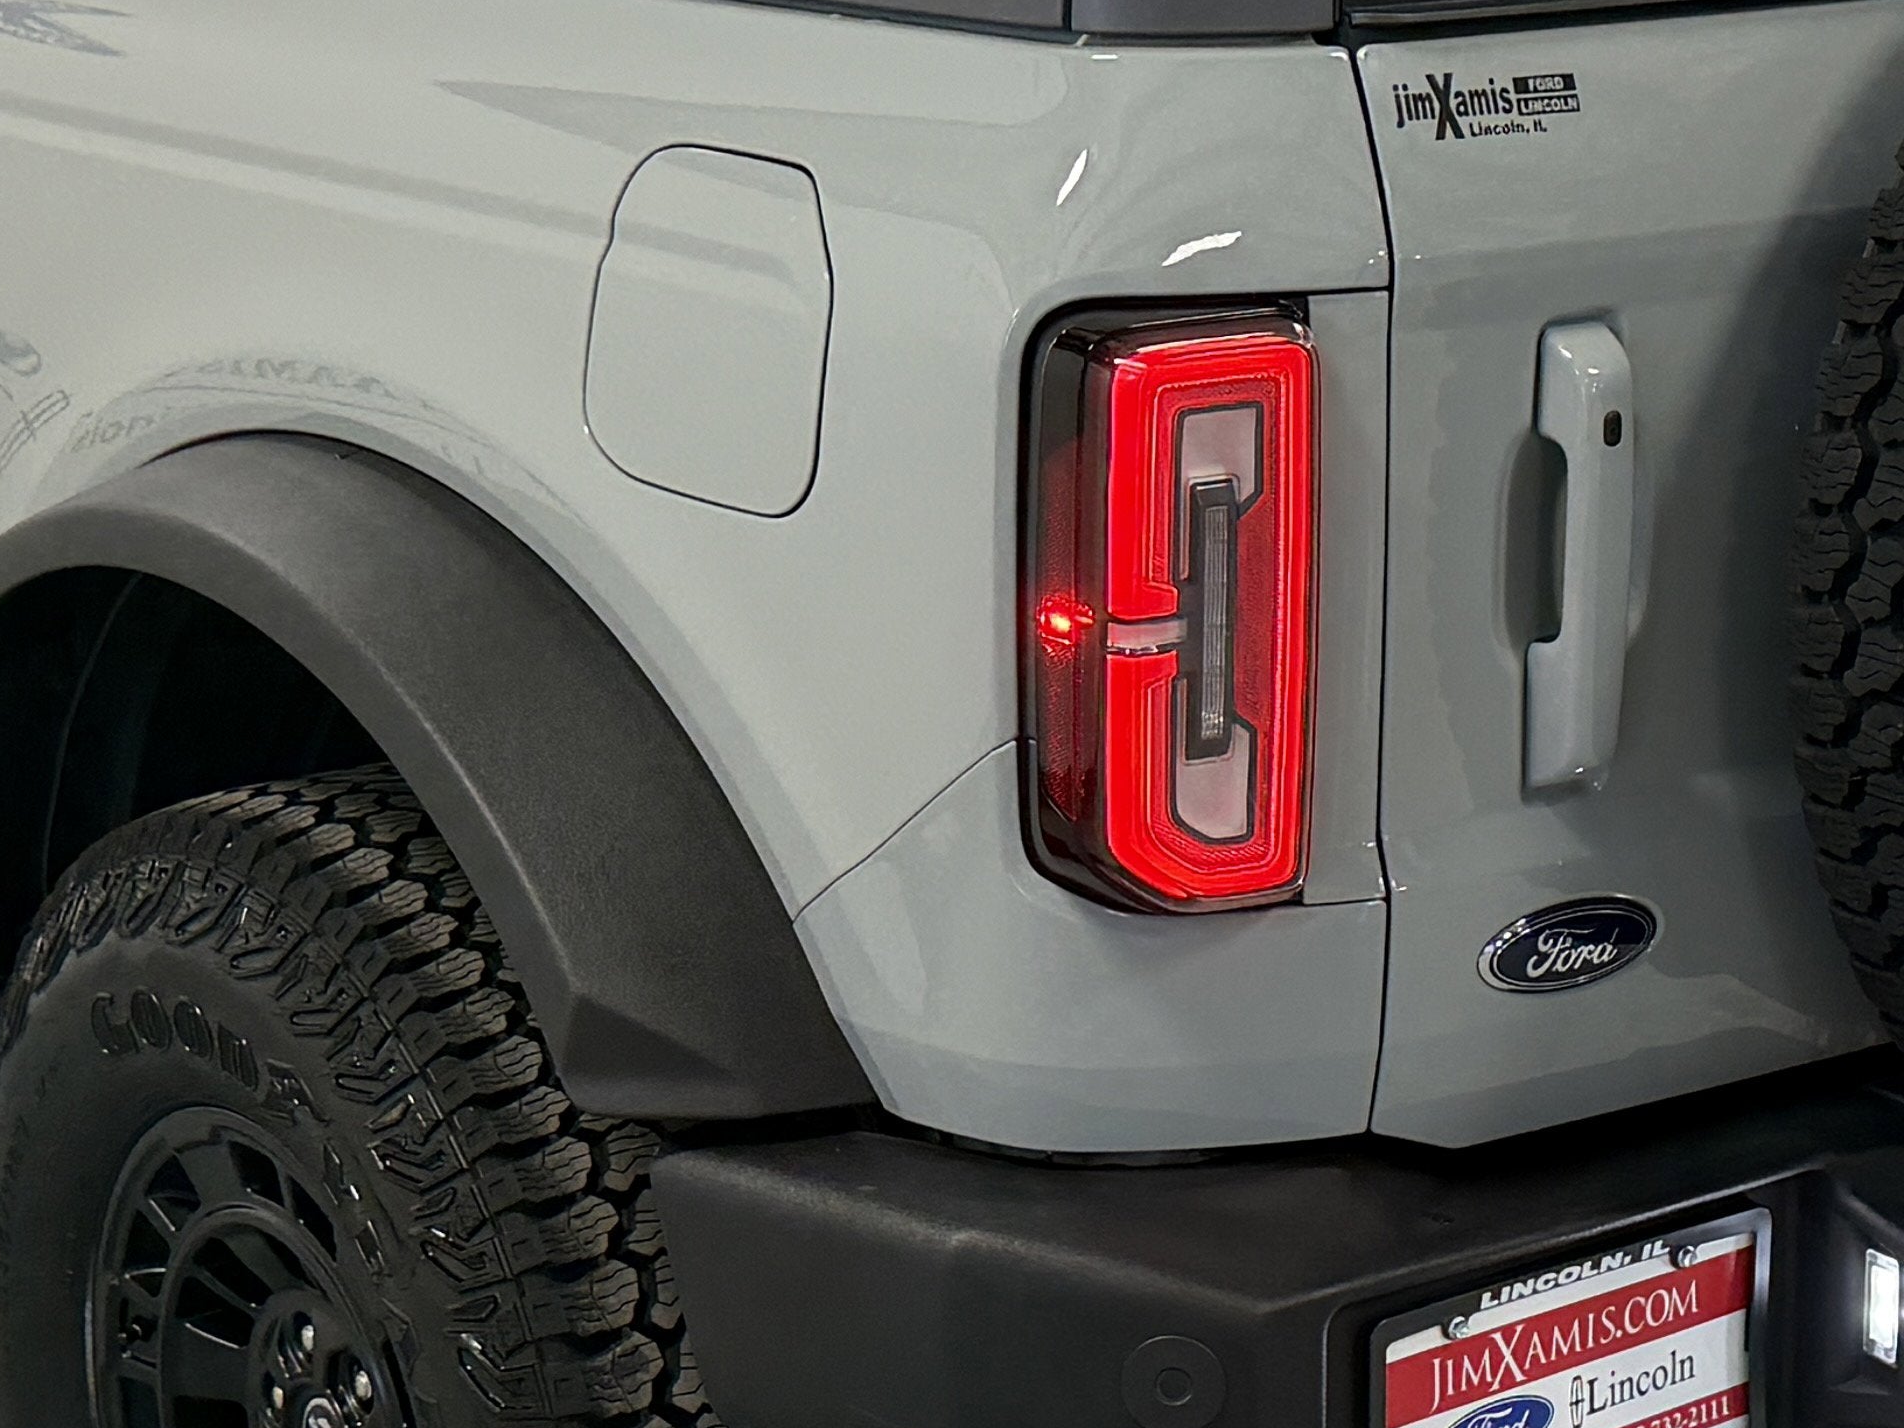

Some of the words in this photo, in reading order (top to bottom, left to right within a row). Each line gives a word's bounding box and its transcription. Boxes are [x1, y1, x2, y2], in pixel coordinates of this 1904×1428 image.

[1527, 76, 1564, 92] FORD
[1519, 96, 1578, 114] LINCOLN
[1526, 927, 1619, 978] Ford
[1641, 1239, 1670, 1259] IL
[1586, 1350, 1696, 1415] Lincoln
